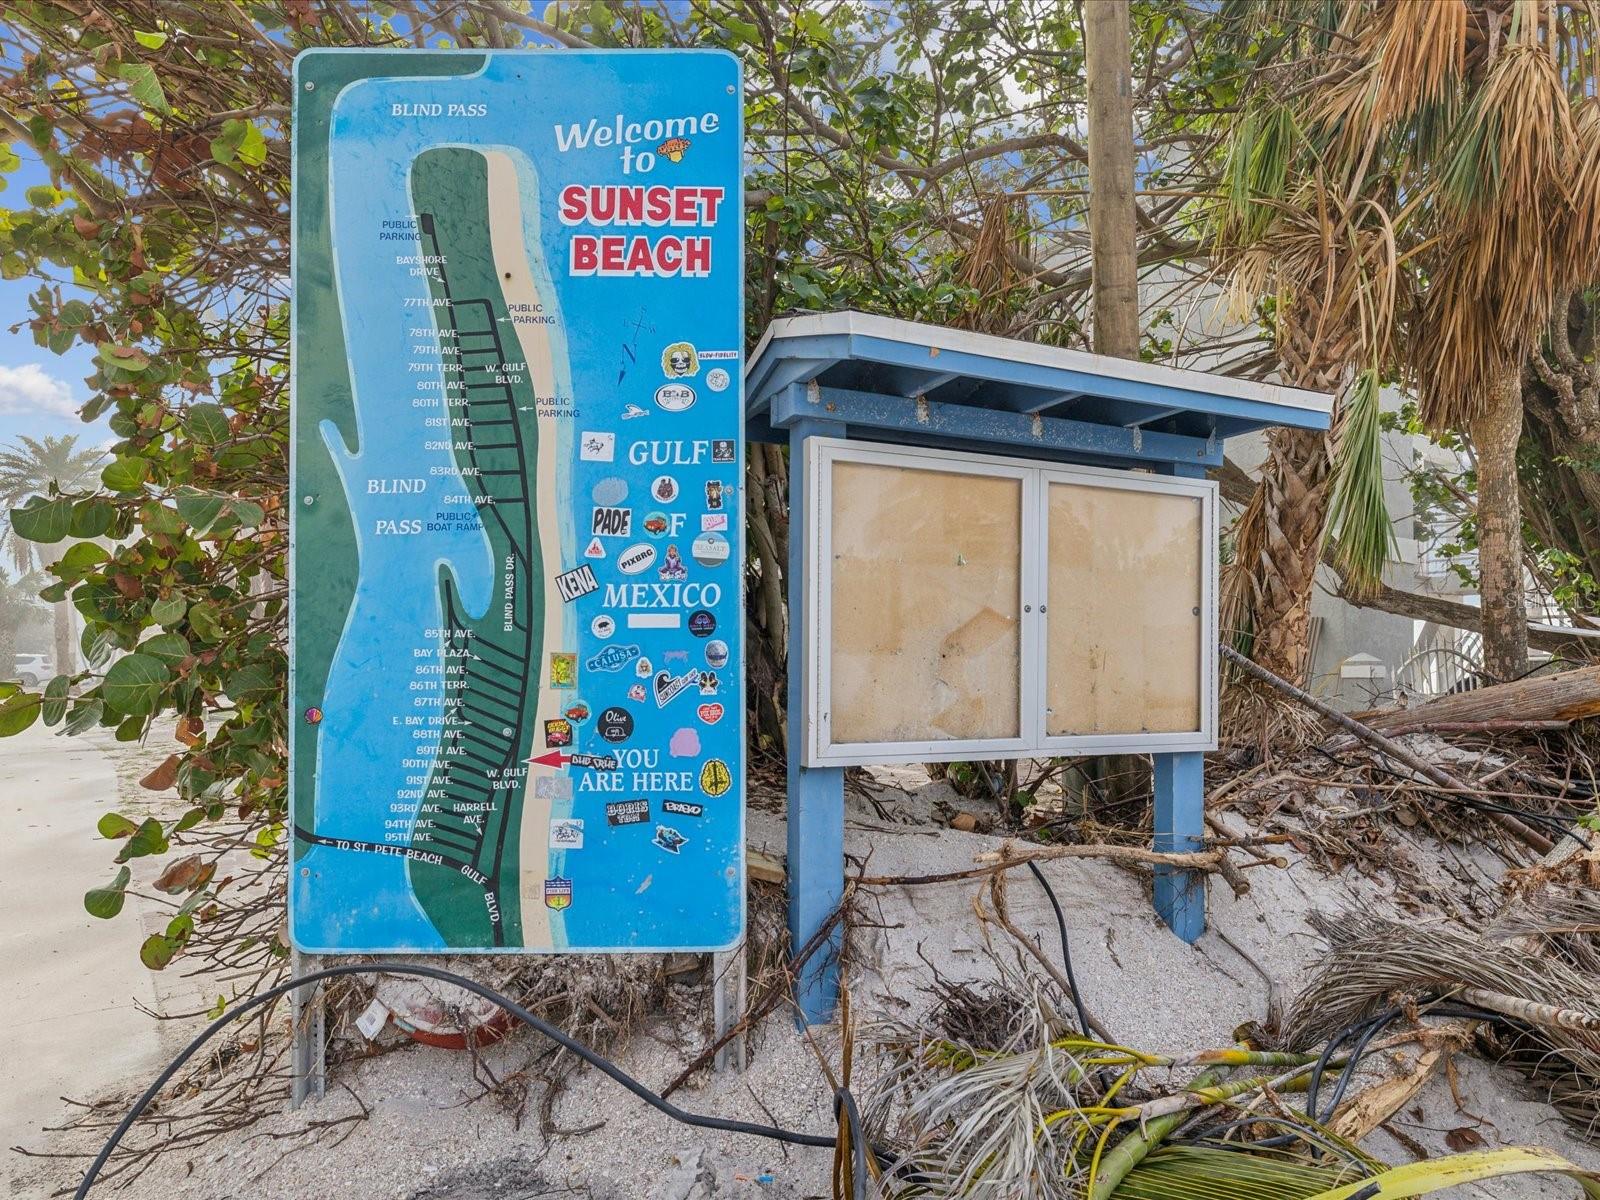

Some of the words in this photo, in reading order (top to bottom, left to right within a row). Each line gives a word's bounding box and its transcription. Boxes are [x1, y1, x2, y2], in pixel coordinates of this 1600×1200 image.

[392, 104, 442, 117] BLIND
[448, 104, 487, 117] PASS
[554, 112, 719, 152] Welcome
[620, 146, 655, 174] to
[559, 185, 724, 226] SUNSET
[382, 220, 417, 229] PUBLIC
[379, 232, 422, 241] PARKING
[396, 256, 447, 265] BAYSHORE
[569, 236, 712, 277] BEACH
[410, 268, 439, 276] DRIVE
[404, 299, 428, 307] 77TH
[433, 299, 454, 307] AVE.
[508, 304, 542, 312] PUBLIC
[514, 316, 556, 324] PARKING
[438, 330, 459, 338] AVE.
[413, 346, 438, 354] 79TH
[442, 347, 462, 355] AVE.
[437, 364, 465, 372] TERR.
[502, 363, 527, 372] GULF
[495, 376, 523, 384] BLVD.
[447, 382, 468, 390] AVE.
[536, 398, 570, 406] PUBLIC
[628, 440, 709, 465] GULF
[367, 479, 426, 494] BLIND
[375, 519, 422, 534] PASS
[668, 513, 687, 537] F
[506, 553, 514, 569] DR.
[505, 573, 514, 599] PASS
[557, 566, 598, 601] KENA
[602, 583, 721, 608] MEXICO
[504, 604, 512, 631] BLIND
[425, 630, 450, 638] 85TH
[455, 630, 475, 638] AVE.
[414, 649, 434, 657] BAY
[594, 651, 632, 668] CALUSA
[416, 666, 442, 674] 86TH
[446, 666, 468, 674] AVE.
[410, 681, 437, 690] 86TH
[442, 681, 469, 689] TERR.
[444, 698, 465, 707] AVE.
[606, 710, 626, 721] Olive
[406, 717, 425, 725] BAY
[428, 716, 457, 725] DRIVE
[413, 730, 440, 738] 88TH
[443, 730, 465, 738] AVE.
[416, 746, 443, 755] 89TH
[446, 747, 467, 755] AVE.
[612, 749, 659, 768] YOU
[432, 760, 452, 769] AVE.
[486, 770, 500, 778] W.
[503, 768, 528, 777] GULF
[406, 776, 428, 784] 91ST
[432, 776, 453, 785] AVE.
[493, 780, 521, 789] BLVD.
[579, 772, 624, 791] ARE
[632, 772, 693, 791] HERE
[390, 804, 418, 812] 93RD
[421, 804, 442, 812] AVE.
[454, 803, 497, 812] HARRELL
[385, 820, 412, 828] 94TH
[415, 820, 436, 828] AVE.
[463, 815, 484, 824] AVE.
[336, 840, 350, 850] TO
[353, 842, 370, 854] ST.
[374, 845, 402, 857] PETE
[406, 849, 443, 865] BEACH
[460, 864, 488, 885] GULF
[484, 892, 500, 925] BLVD.
